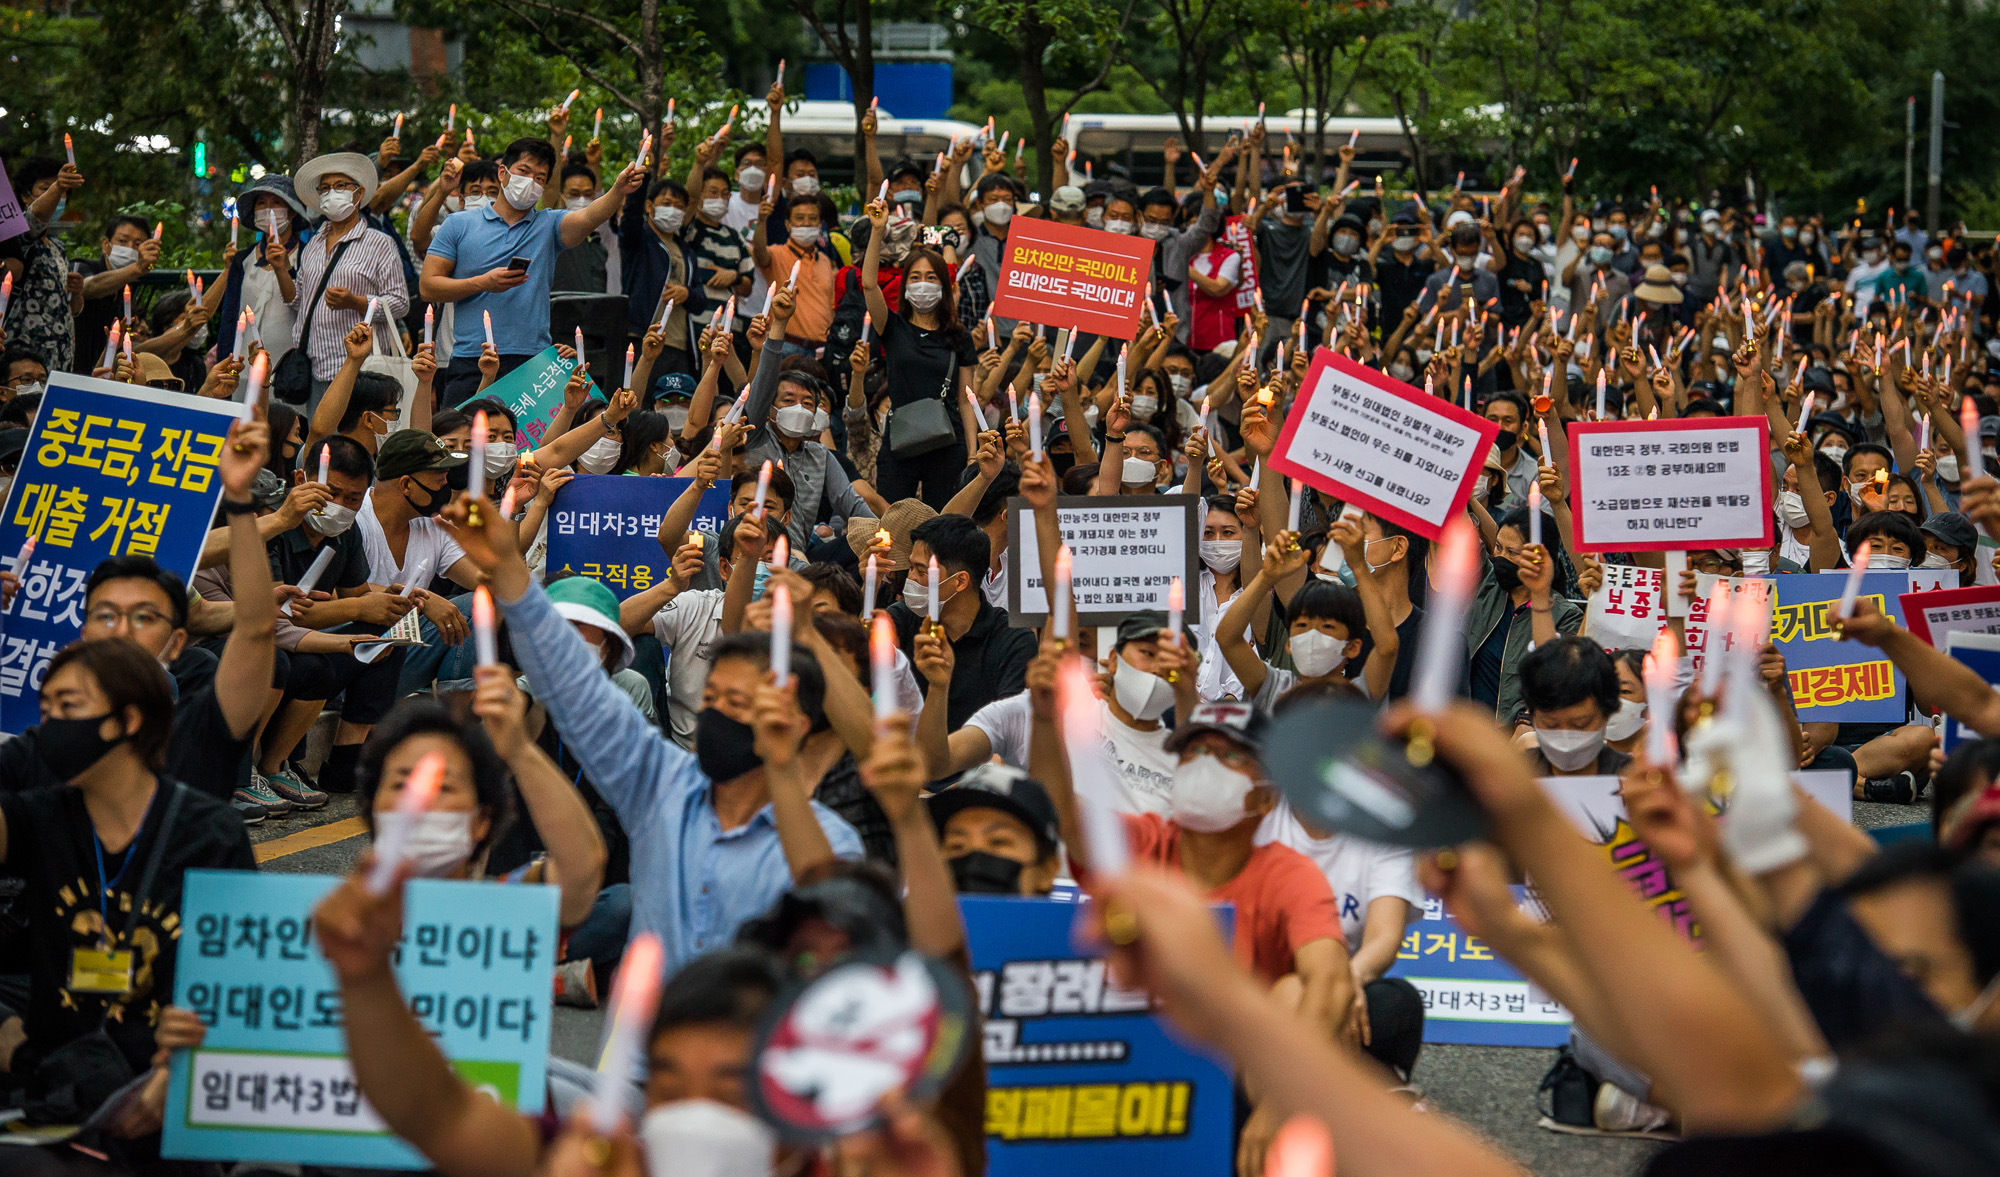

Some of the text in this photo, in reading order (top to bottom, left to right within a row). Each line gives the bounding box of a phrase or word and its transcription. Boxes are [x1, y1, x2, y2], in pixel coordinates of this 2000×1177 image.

[1013, 247, 1138, 285] 임차인만 국민이냐,
[1008, 270, 1136, 308] 임대인도 국민이다!
[510, 392, 537, 418] 득세
[532, 356, 574, 398] 소급적용
[1330, 383, 1361, 404] 부동산
[1363, 396, 1402, 421] 임대법인
[1402, 413, 1433, 435] 징벌적
[1433, 427, 1465, 449] 과세??
[37, 407, 226, 493] 중도금, 잔금
[1309, 410, 1340, 431] 부동산
[1340, 422, 1371, 445] 법인이
[1372, 437, 1391, 455] 무슨
[1392, 446, 1414, 465] 죄를
[1591, 440, 1740, 458] 대한민국 정부, 국회의원 헌법
[1311, 448, 1431, 507] 누가 사형 선고를 내렸나요?
[1607, 465, 1631, 477] 13조
[13, 482, 172, 558] 대출 거절
[1103, 512, 1140, 523] 대한민국
[1143, 512, 1161, 523] 정부
[1667, 495, 1712, 509] 재산권을
[1716, 494, 1750, 507] 박탈당
[556, 511, 661, 538] 임대차3법
[1079, 529, 1115, 540] 개돼지로
[1118, 529, 1137, 540] 아는
[1140, 528, 1158, 539] 정부
[1627, 519, 1650, 531] 하지
[1080, 545, 1117, 556] 국가경제
[1120, 544, 1166, 555] 운영하더니
[1084, 594, 1103, 604] 법인
[1106, 593, 1133, 604] 징벌적
[196, 912, 541, 972] 임차인 민이냐
[186, 982, 538, 1042] 임대인도 민이다
[1421, 989, 1526, 1013] 임대차3법
[202, 1069, 362, 1117] 임대차3법
